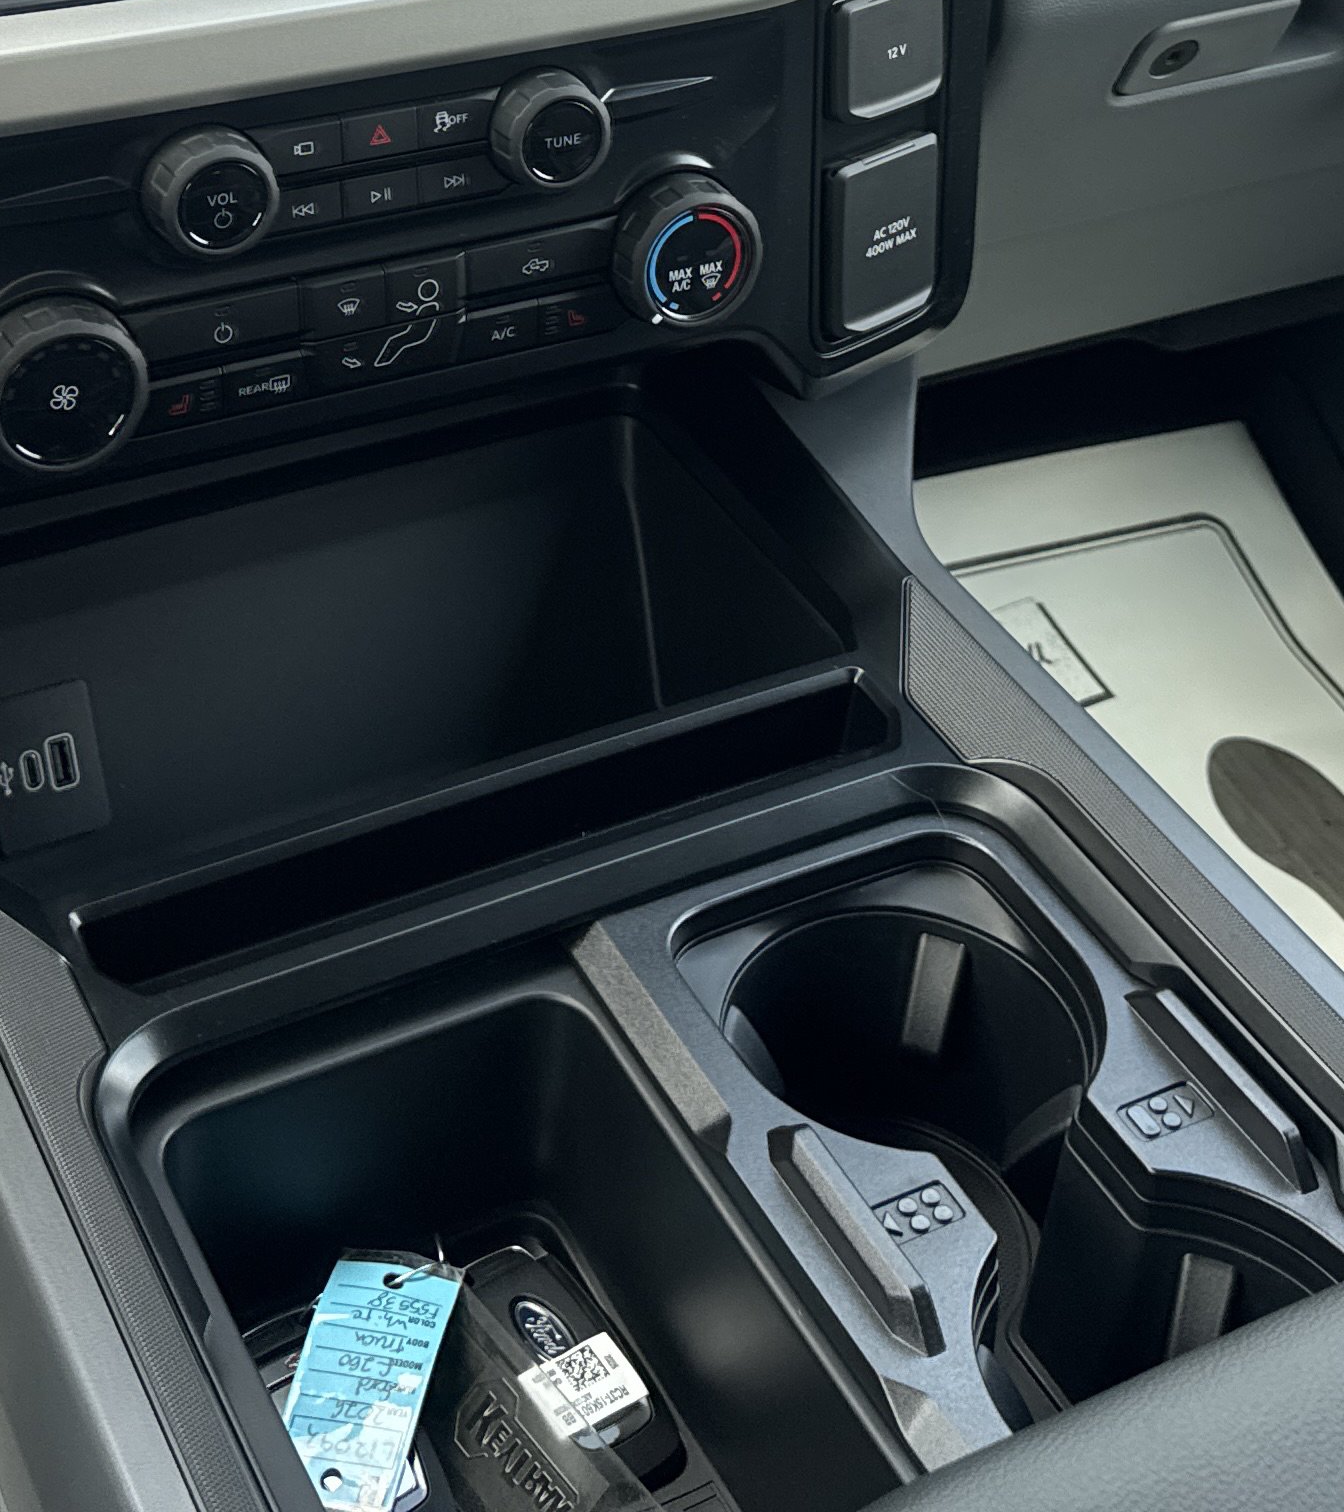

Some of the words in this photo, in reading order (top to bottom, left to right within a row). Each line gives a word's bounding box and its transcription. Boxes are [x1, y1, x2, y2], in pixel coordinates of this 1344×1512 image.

[447, 112, 469, 126] OFF
[544, 132, 582, 150] TUNE
[207, 191, 238, 207] VOL
[865, 237, 895, 258] 400W
[895, 227, 917, 246] MAX
[668, 267, 693, 282] MAX
[699, 260, 723, 276] MAX
[671, 278, 692, 293] A/C
[490, 325, 516, 342] A/C
[238, 382, 270, 398] REAR
[407, 1315, 436, 1329] COLOR
[406, 1338, 430, 1349] BODY
